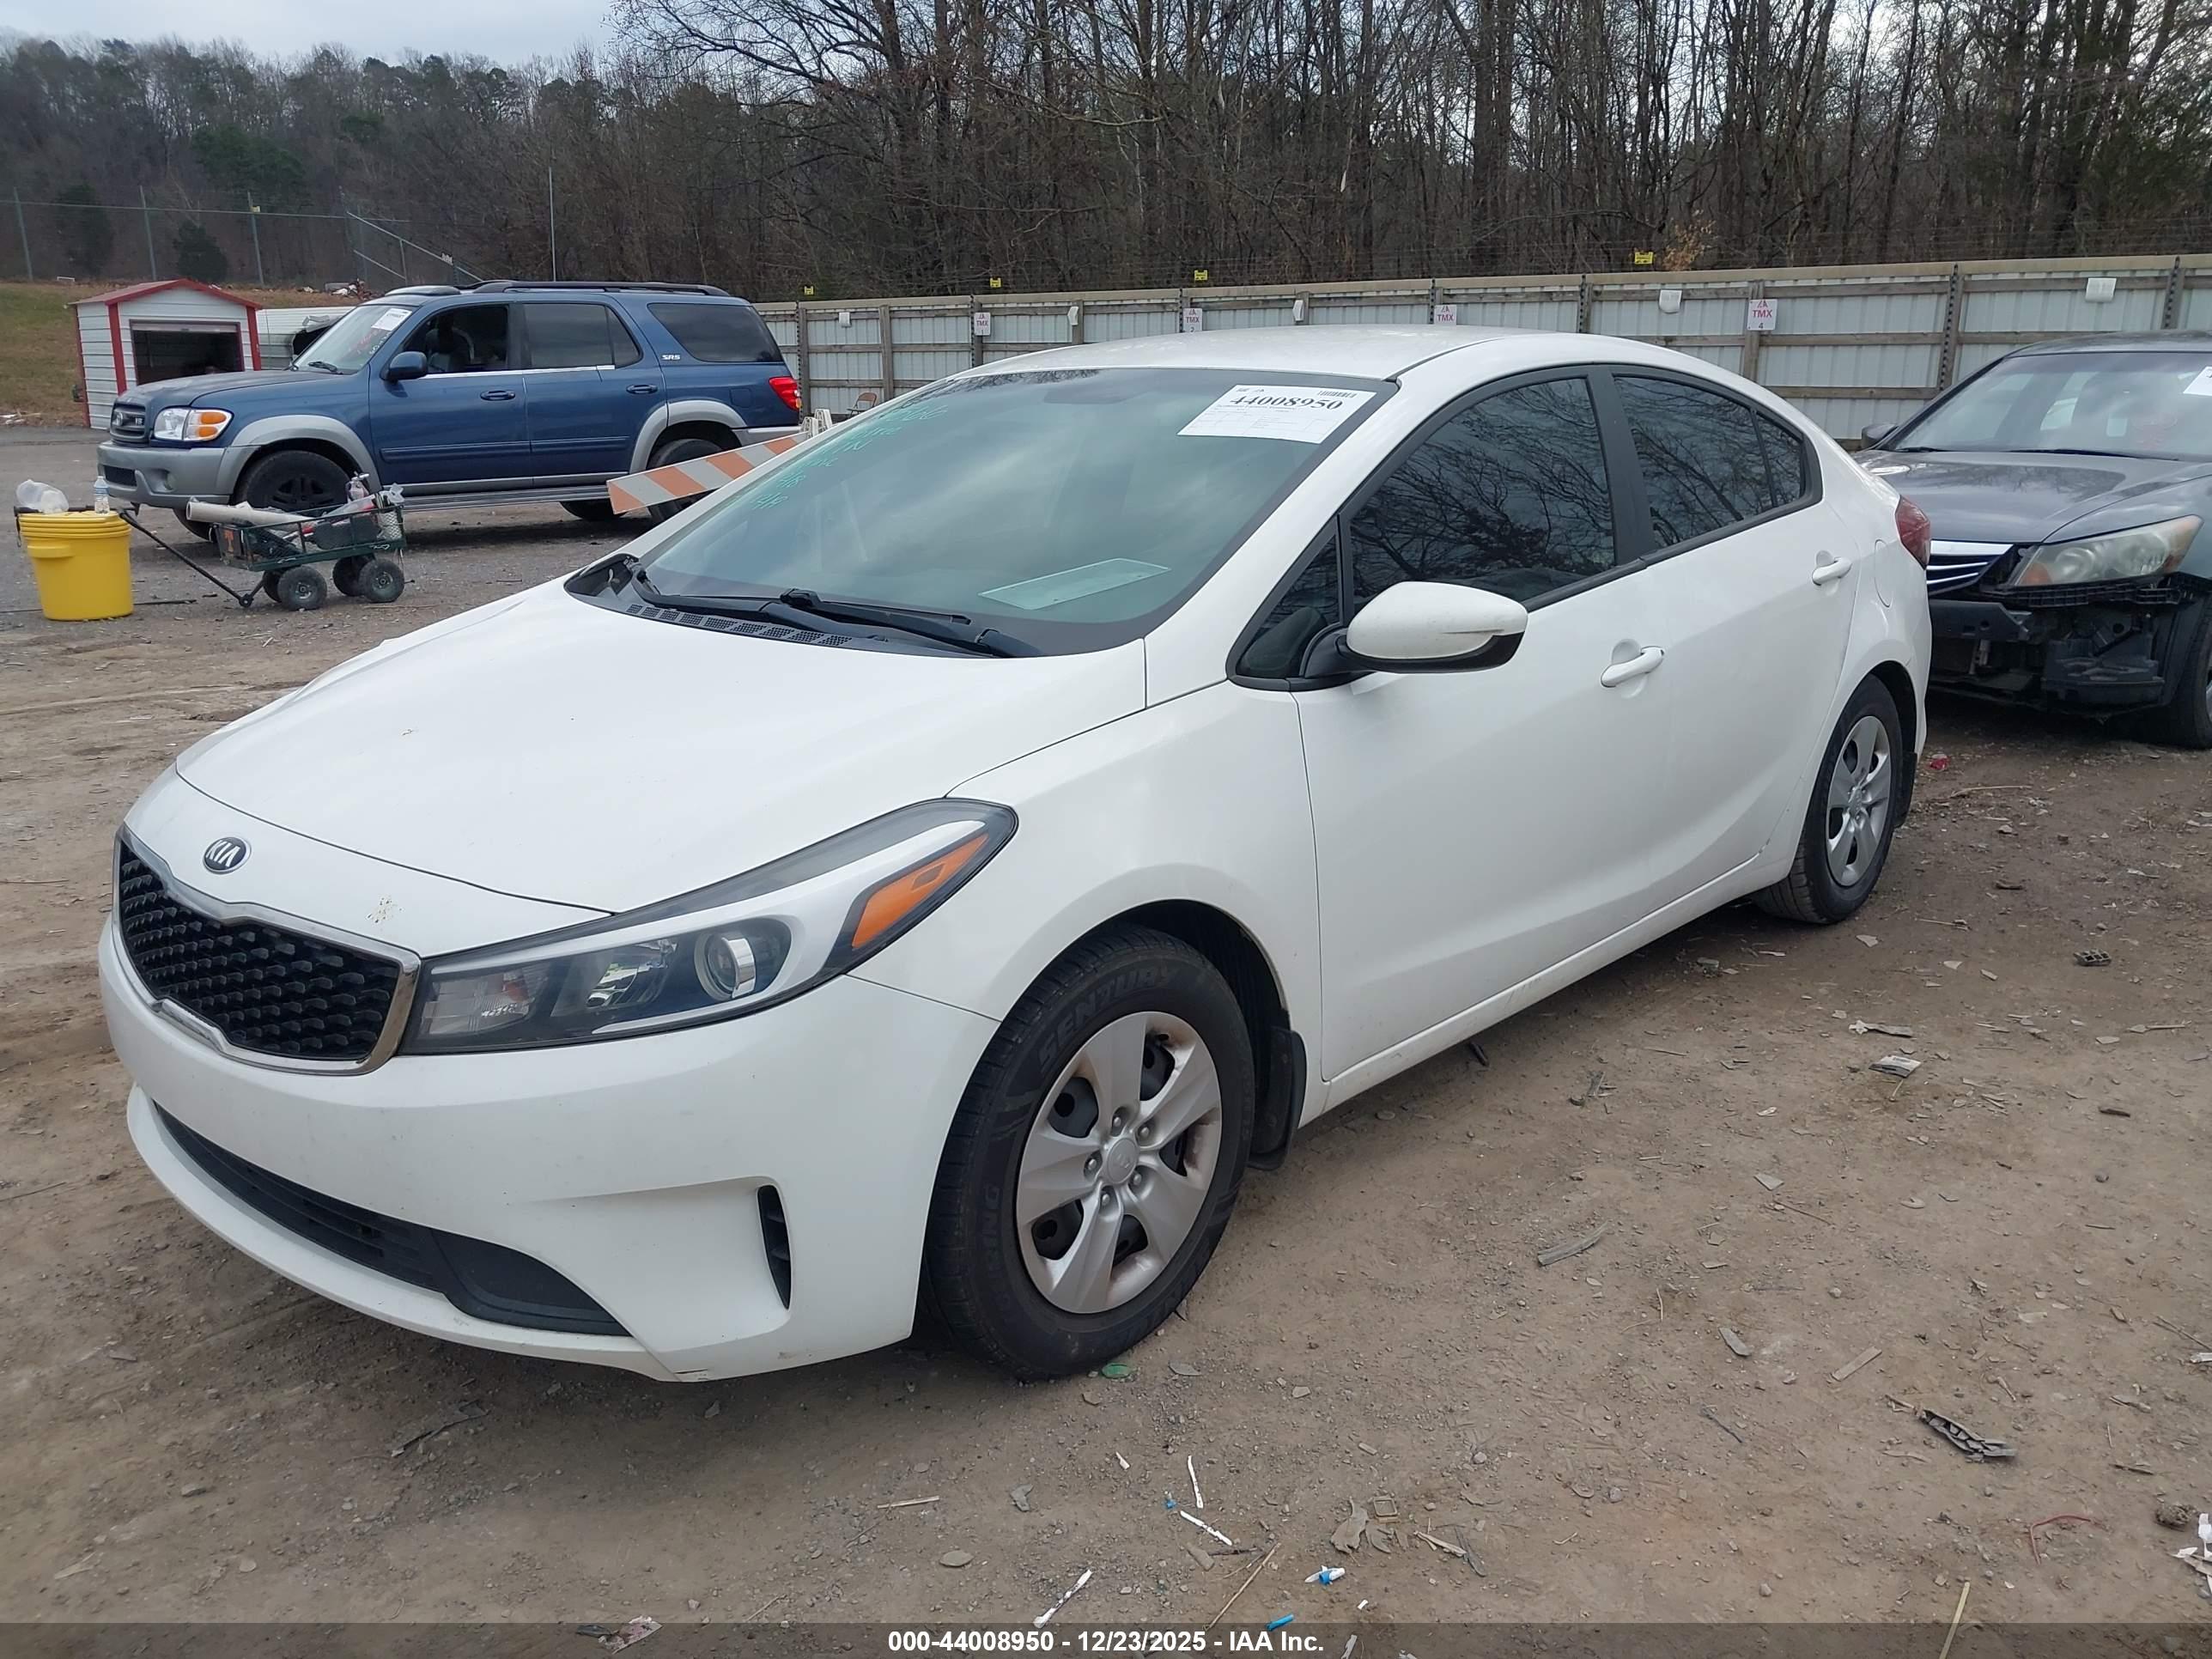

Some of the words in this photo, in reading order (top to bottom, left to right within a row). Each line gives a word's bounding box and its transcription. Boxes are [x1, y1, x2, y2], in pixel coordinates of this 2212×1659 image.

[1437, 313, 1454, 322] TMX
[1753, 309, 1773, 318] TMX
[1230, 395, 1343, 410] 44008950
[205, 839, 241, 868] KIA
